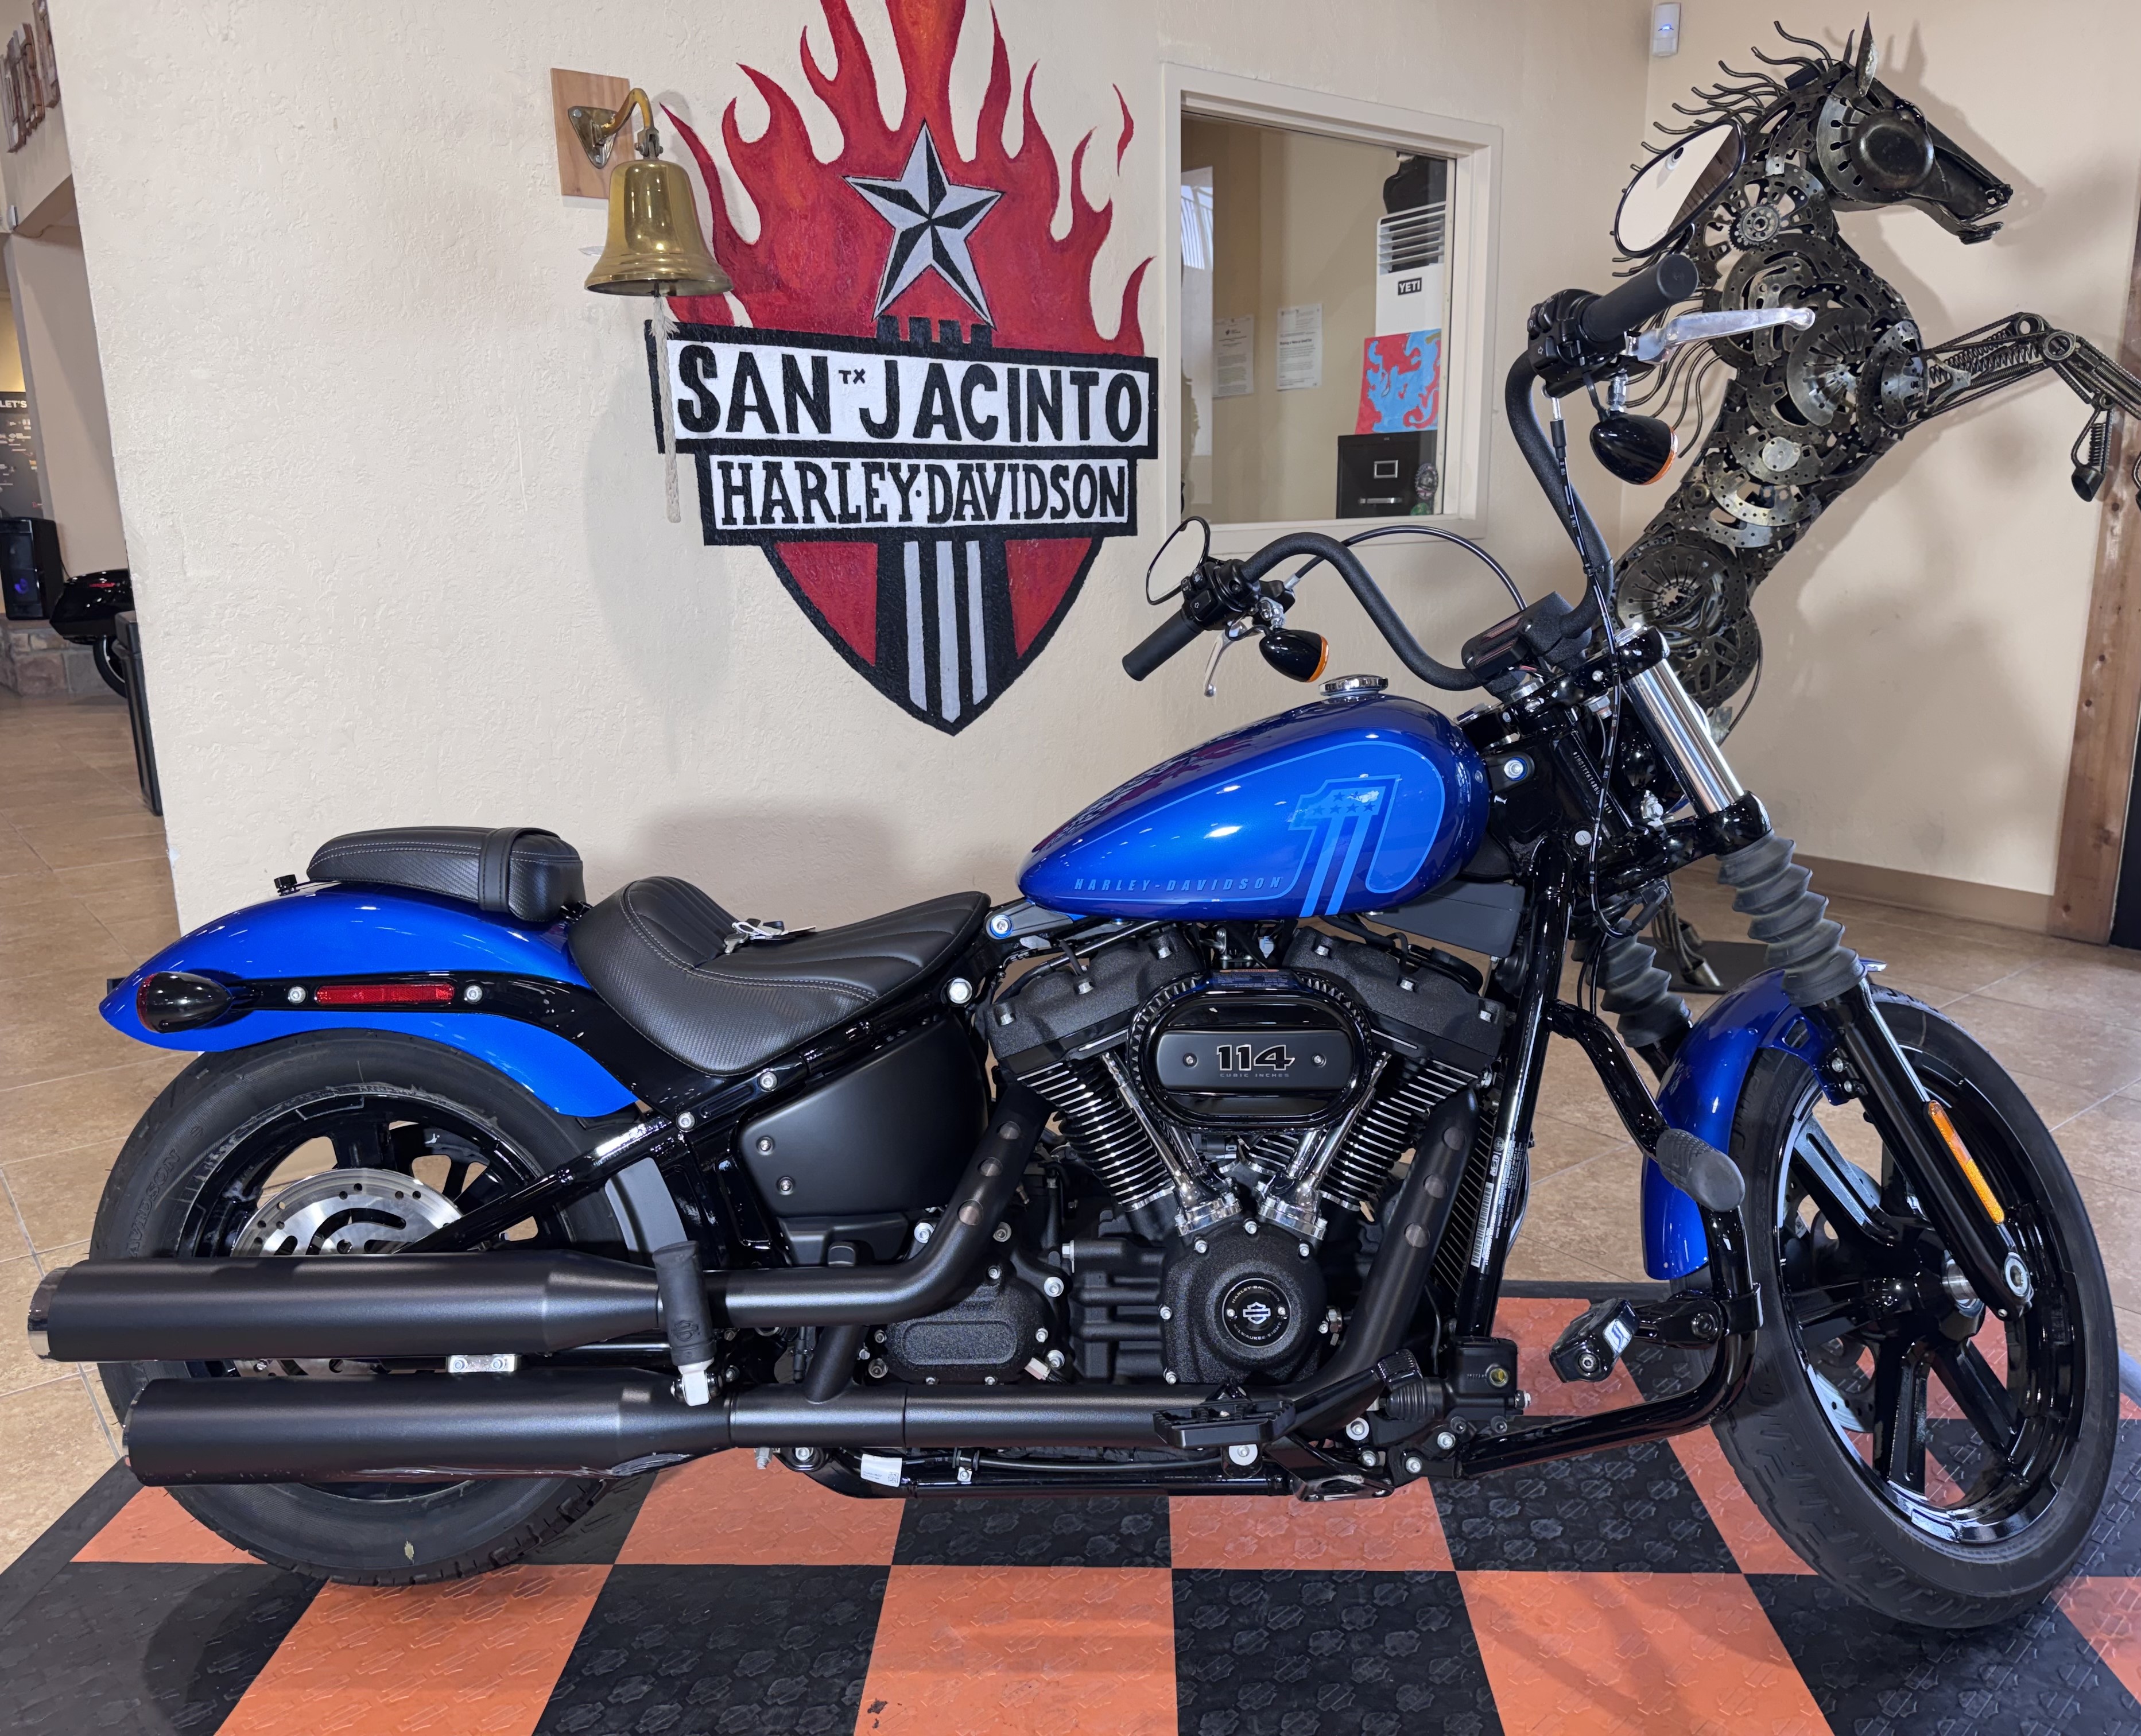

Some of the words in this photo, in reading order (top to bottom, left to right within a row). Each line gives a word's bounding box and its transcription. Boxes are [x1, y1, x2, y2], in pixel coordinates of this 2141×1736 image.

[1399, 280, 1421, 293] YETI
[678, 344, 831, 433] SAN
[839, 369, 866, 384] TX
[859, 359, 1141, 442] JACINTO
[0, 400, 28, 408] LET'S
[1075, 877, 1281, 892] HARLEY-DAVIDSON
[1216, 1044, 1296, 1071] 114
